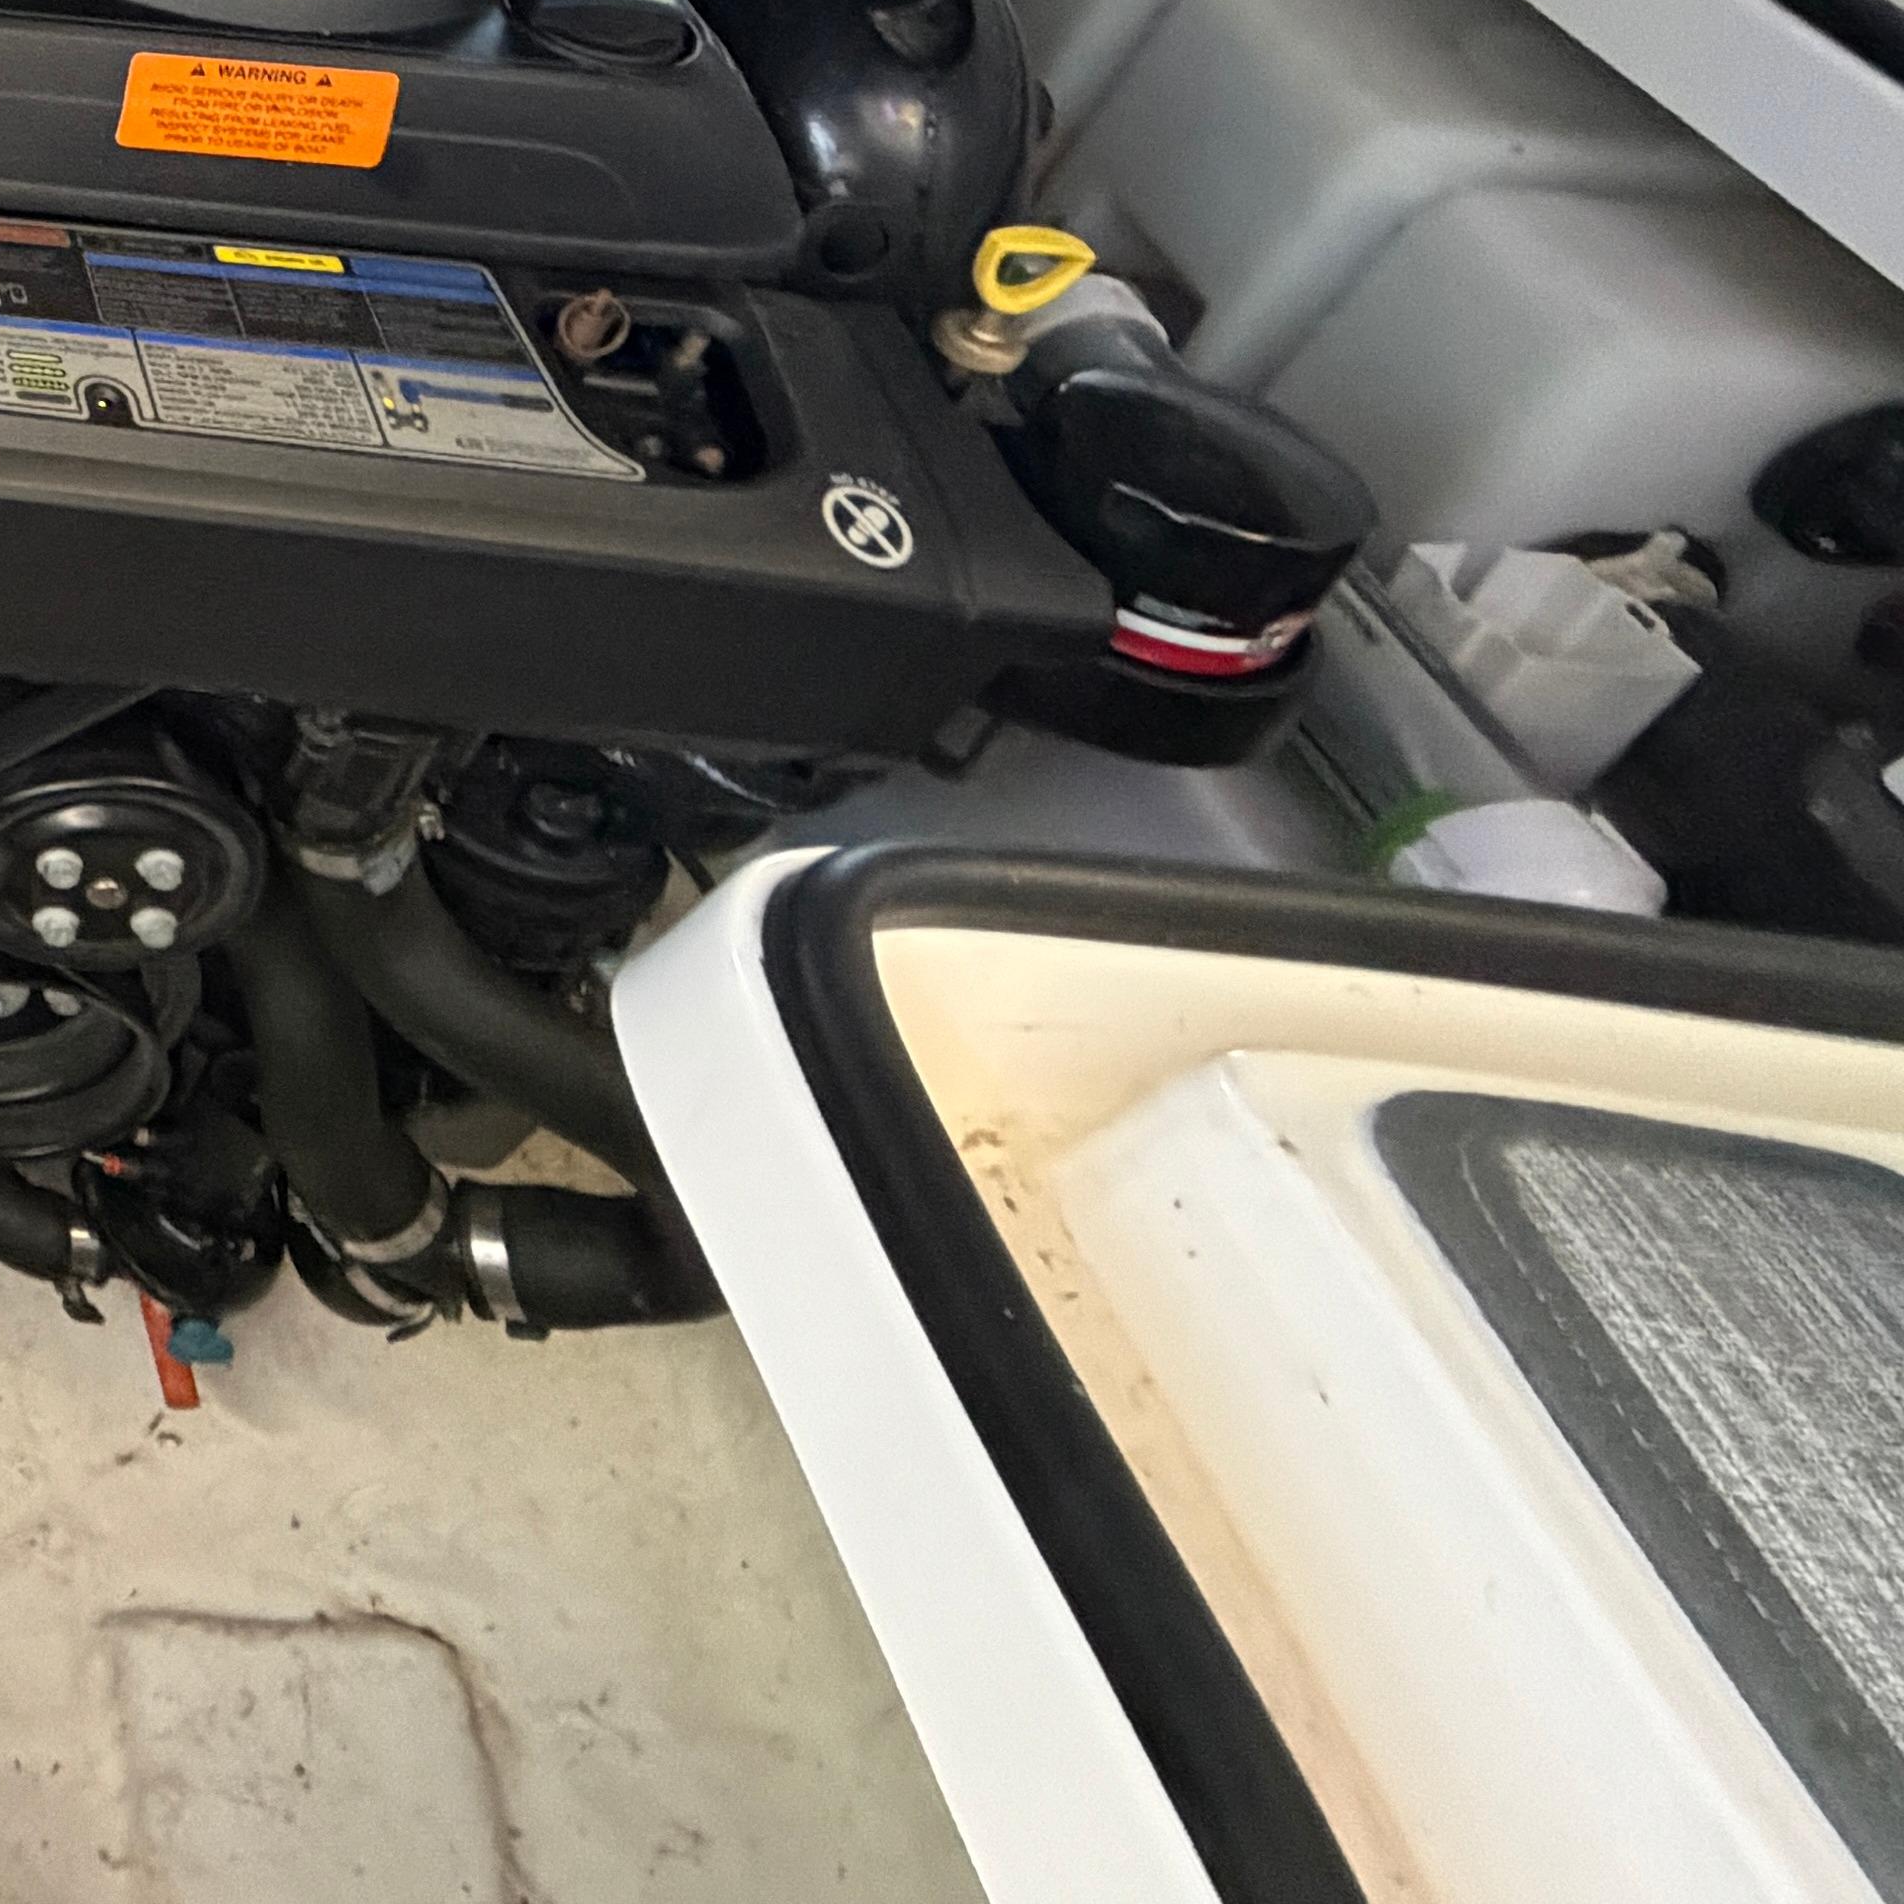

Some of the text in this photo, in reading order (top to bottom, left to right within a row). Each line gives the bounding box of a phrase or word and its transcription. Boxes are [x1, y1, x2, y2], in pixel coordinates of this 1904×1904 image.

[218, 64, 307, 85] WARNING
[173, 97, 209, 108] FROM
[212, 100, 240, 111] FIRE
[243, 102, 262, 112] OR
[192, 85, 247, 99] SERIOUS
[251, 91, 294, 104] INJURY
[298, 95, 318, 105] OR
[320, 96, 364, 108] DEATH
[150, 107, 220, 123] RESULTING
[223, 114, 260, 125] FROM
[263, 118, 317, 131] LEAKING
[156, 120, 209, 133] INSPECT
[275, 131, 301, 141] FOR
[304, 133, 346, 145] LEAKS
[164, 133, 203, 143] PRIOR
[207, 136, 224, 146] TO
[273, 142, 289, 152] OF
[293, 143, 329, 155] BOAT
